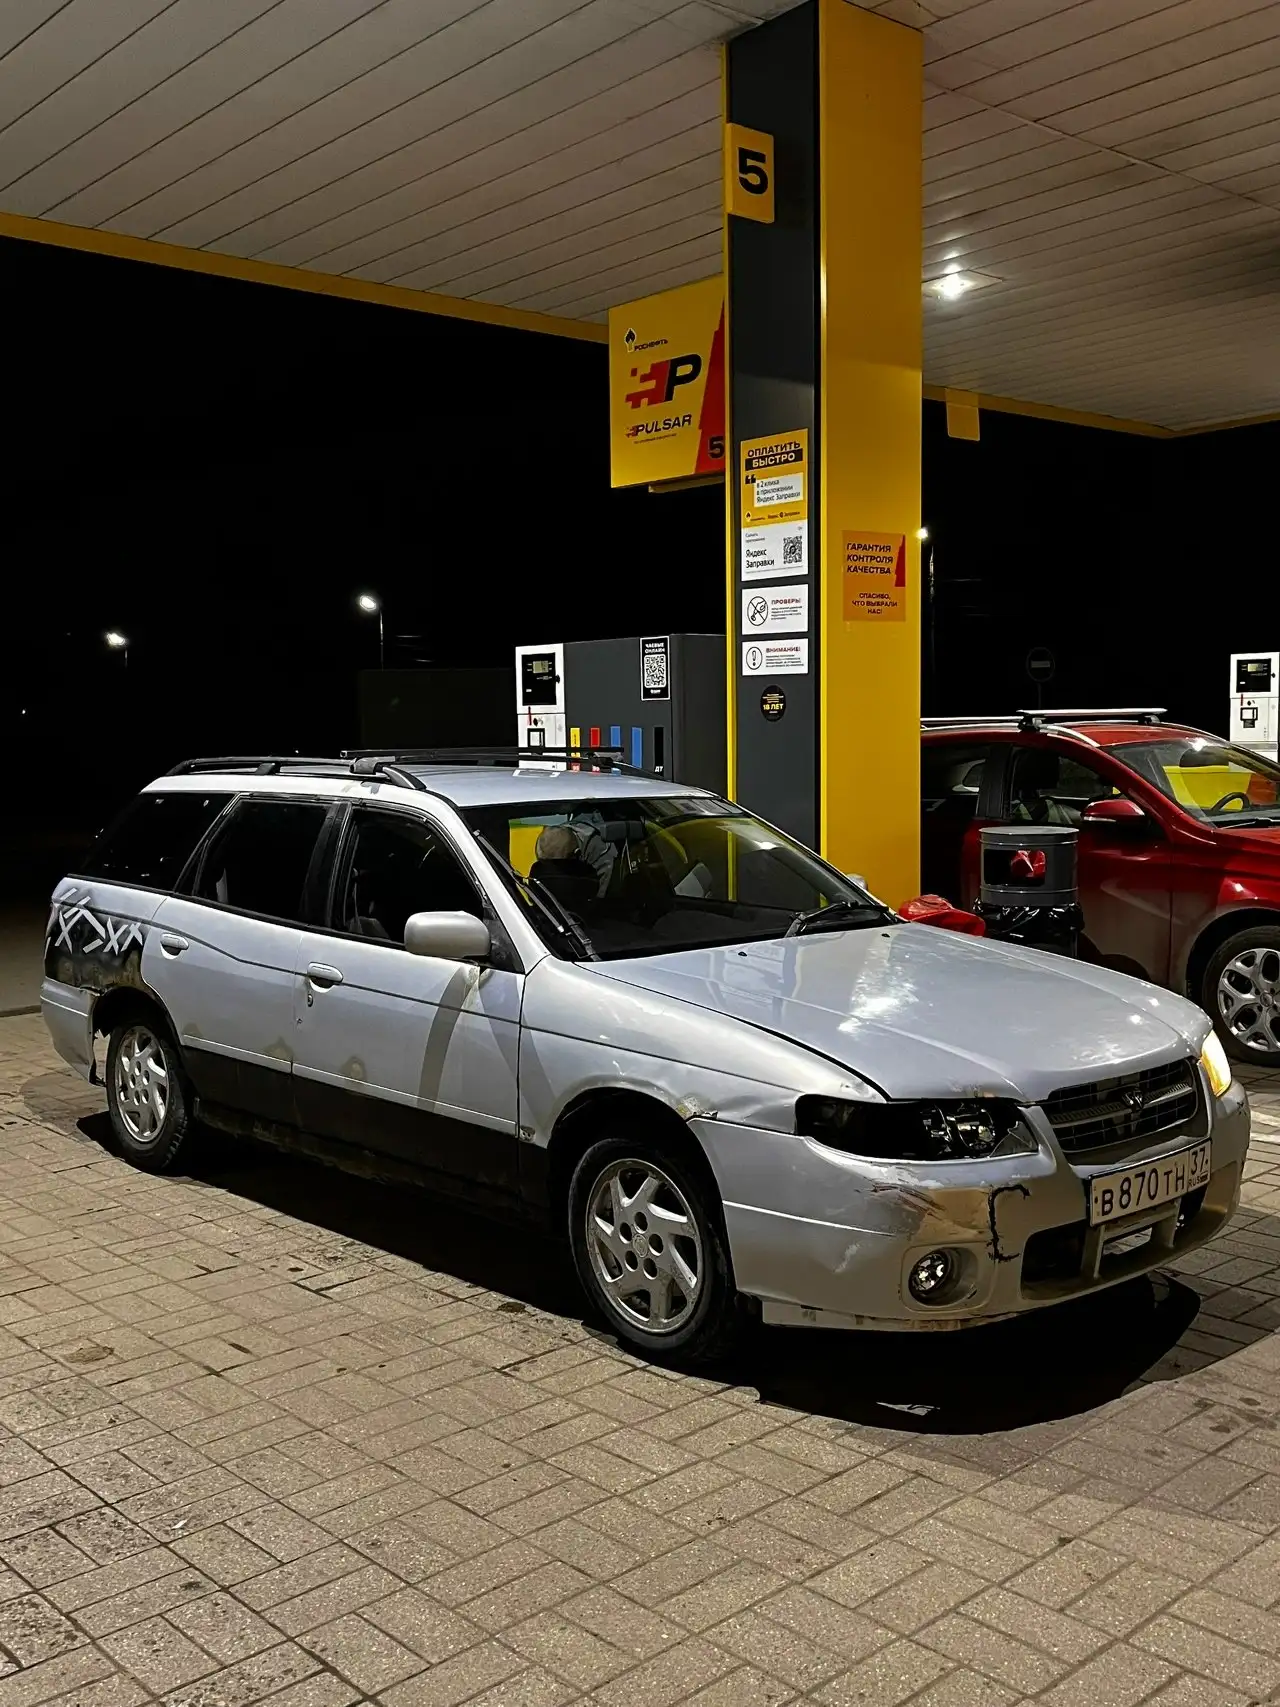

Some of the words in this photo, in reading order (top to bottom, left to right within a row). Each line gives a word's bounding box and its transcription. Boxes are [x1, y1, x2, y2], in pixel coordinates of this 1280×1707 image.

[739, 147, 768, 195] 5
[634, 339, 669, 352] РОСНЕФТЬ
[635, 413, 692, 436] PULSAR
[747, 441, 800, 457] ОПЛАТИТЬ
[752, 452, 796, 468] БЫСТРО
[760, 485, 794, 495] приложении
[756, 495, 775, 503] Яндекс
[776, 492, 801, 501] Заправки
[846, 543, 892, 553] ГАРАНТИЯ
[745, 549, 767, 558] Яндекс
[846, 554, 894, 563] КОНТРОЛЯ
[745, 559, 775, 569] Заправки
[846, 565, 891, 575] КАЧЕСТВА
[765, 646, 801, 654] ВНИМАНИЕ!
[770, 703, 784, 711] ЛЕТ
[1191, 1146, 1206, 1176] 37
[1188, 1176, 1201, 1188] RUS
